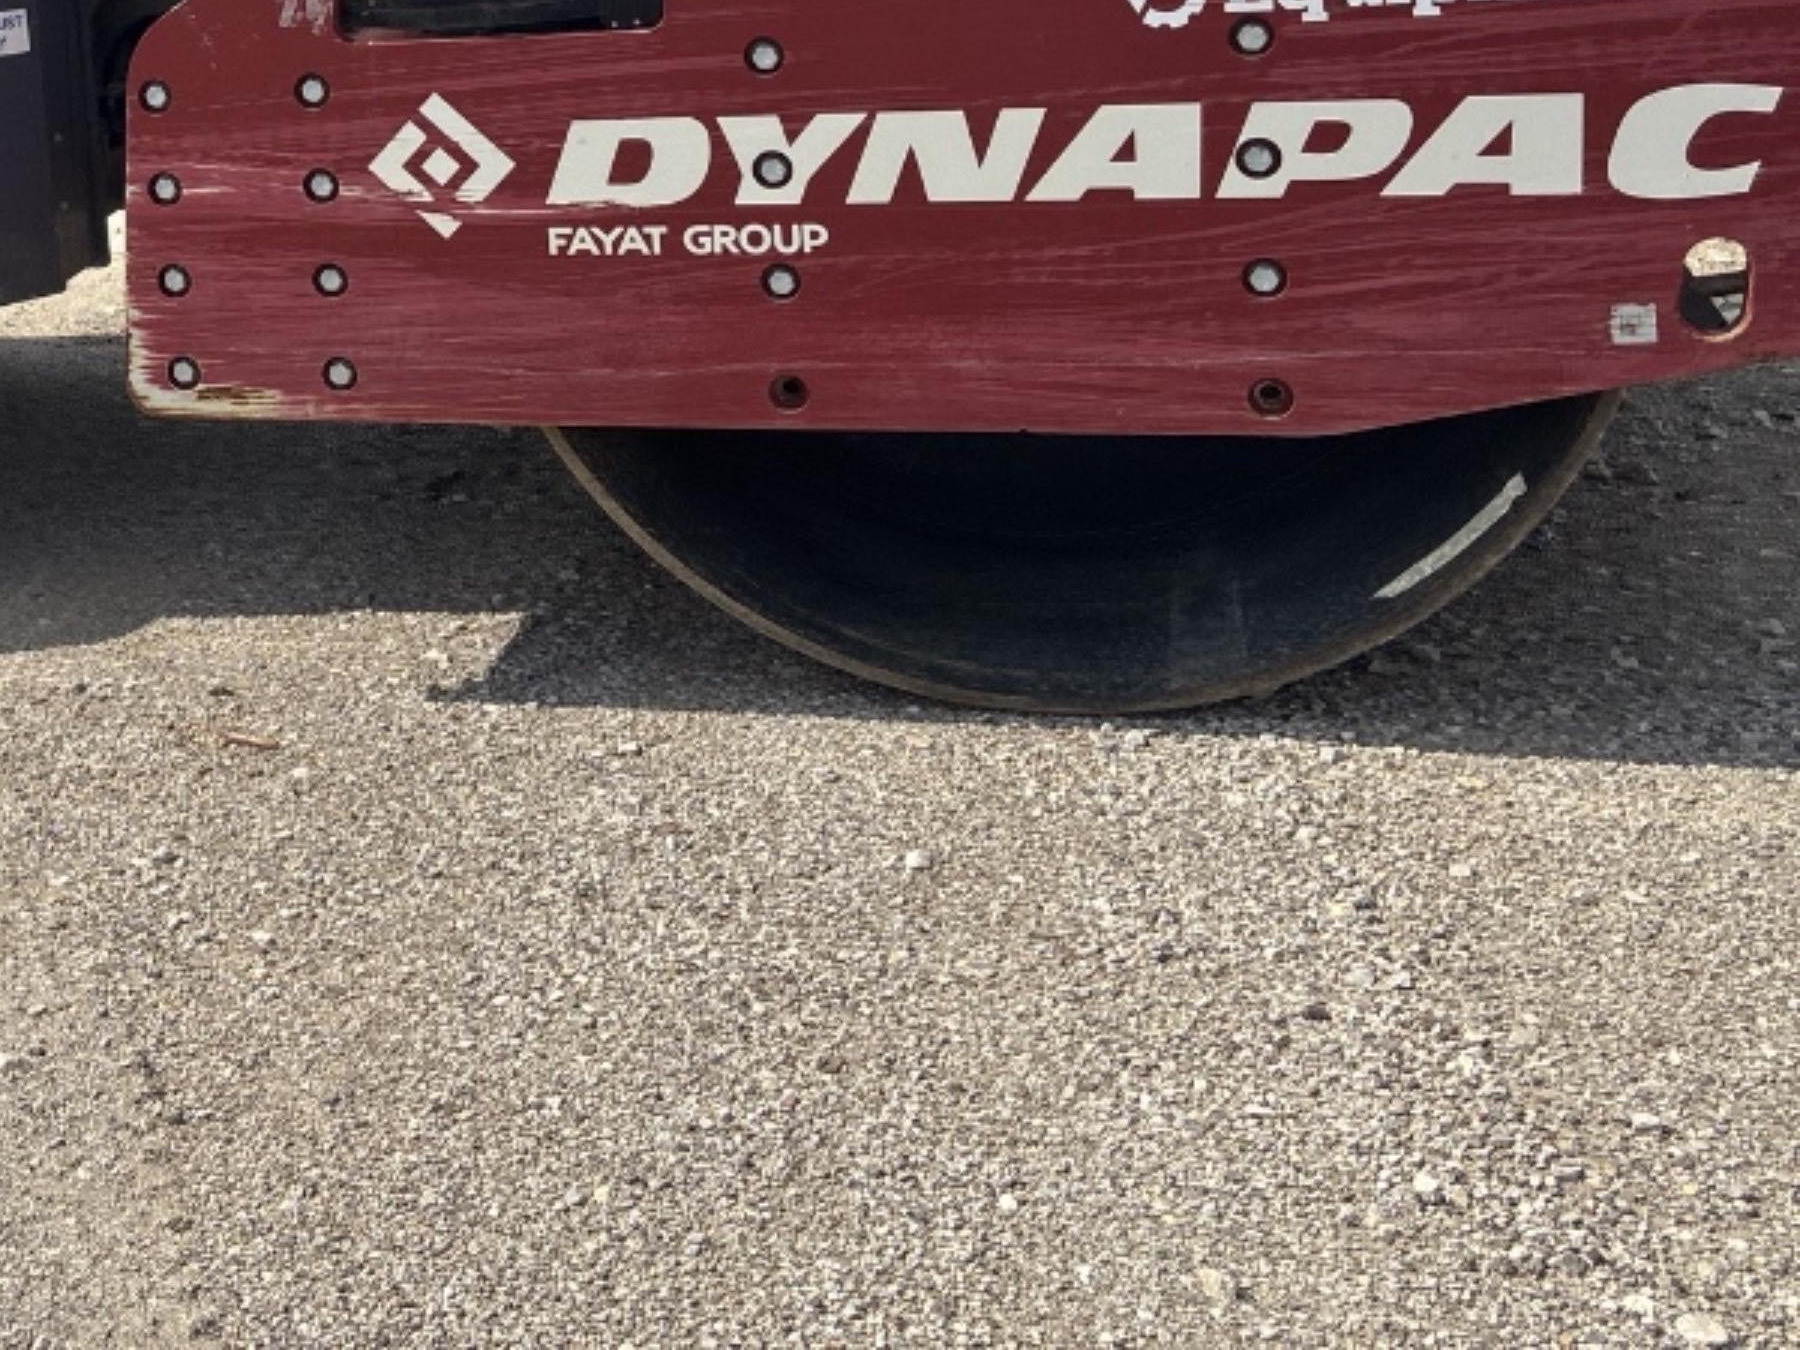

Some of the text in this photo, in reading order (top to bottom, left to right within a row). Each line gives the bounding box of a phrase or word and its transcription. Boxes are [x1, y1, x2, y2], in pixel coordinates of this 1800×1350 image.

[545, 82, 1784, 208] DYNAPAC
[547, 222, 830, 257] FAYAT GROUP
